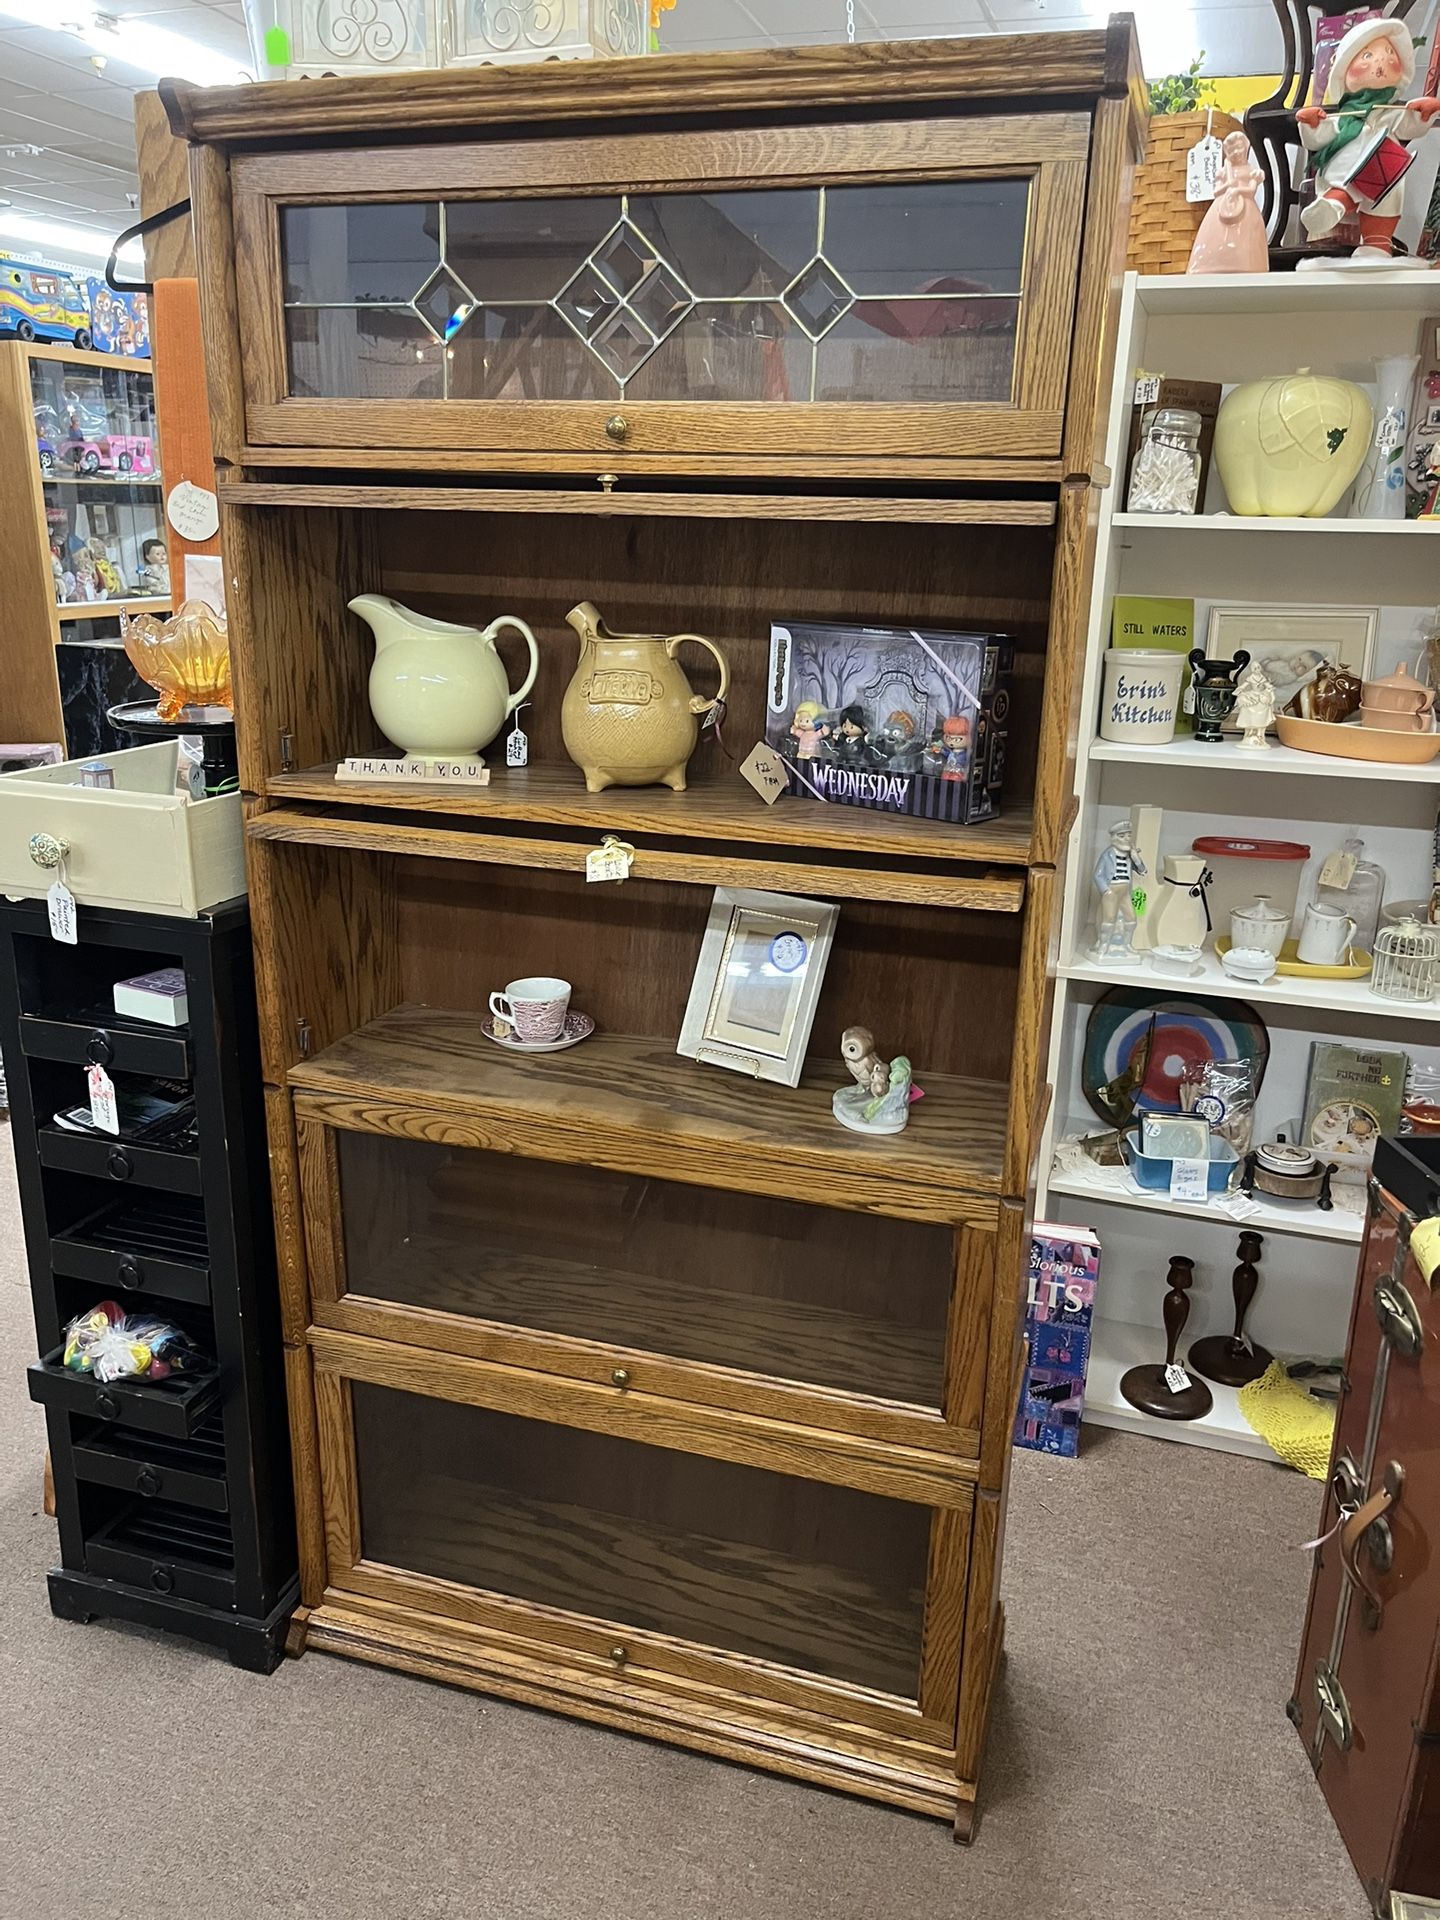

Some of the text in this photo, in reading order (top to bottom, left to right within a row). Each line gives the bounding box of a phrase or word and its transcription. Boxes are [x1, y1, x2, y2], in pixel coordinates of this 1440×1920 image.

[1123, 623, 1187, 637] STILL WATERS
[1117, 674, 1167, 700] Erin's
[1111, 702, 1172, 724] Kitchen
[349, 761, 477, 777] THANK YOU
[811, 762, 911, 807] WEDNESDAY
[1356, 1054, 1382, 1066] LOOK
[1335, 1069, 1381, 1085] FURTHER
[1367, 1065, 1382, 1075] NO
